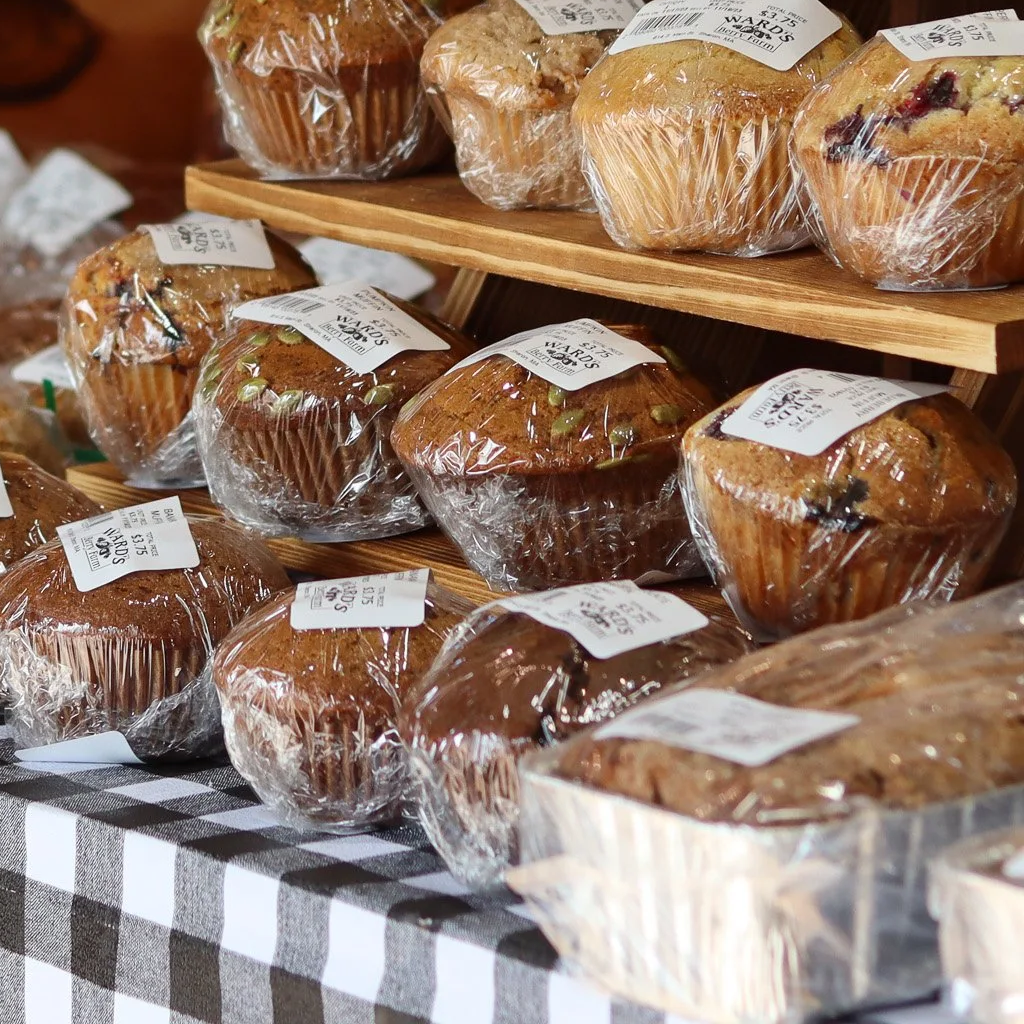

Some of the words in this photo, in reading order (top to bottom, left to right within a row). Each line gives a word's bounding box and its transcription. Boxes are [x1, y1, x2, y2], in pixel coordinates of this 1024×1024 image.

[758, 10, 799, 28] $3.75
[766, 4, 787, 15] TOTAL
[788, 11, 808, 24] PRICE
[718, 26, 747, 40] Berry
[747, 34, 775, 51] Farm
[724, 15, 795, 43] WARD'S
[323, 323, 344, 338] Berry
[343, 336, 366, 354] Farm
[336, 314, 389, 346] WARD'S
[369, 319, 398, 337] $3.75
[530, 346, 553, 363] Berry
[552, 362, 576, 375] Farm
[544, 341, 601, 369] WARD'S
[578, 341, 613, 359] $3.75
[751, 398, 777, 418] Farm
[764, 387, 825, 429] WARD'S
[788, 403, 823, 427] $3.75
[103, 527, 130, 565] WARD'S
[131, 534, 149, 556] $3.75
[89, 550, 101, 570] Farm
[361, 586, 375, 605] $3.75
